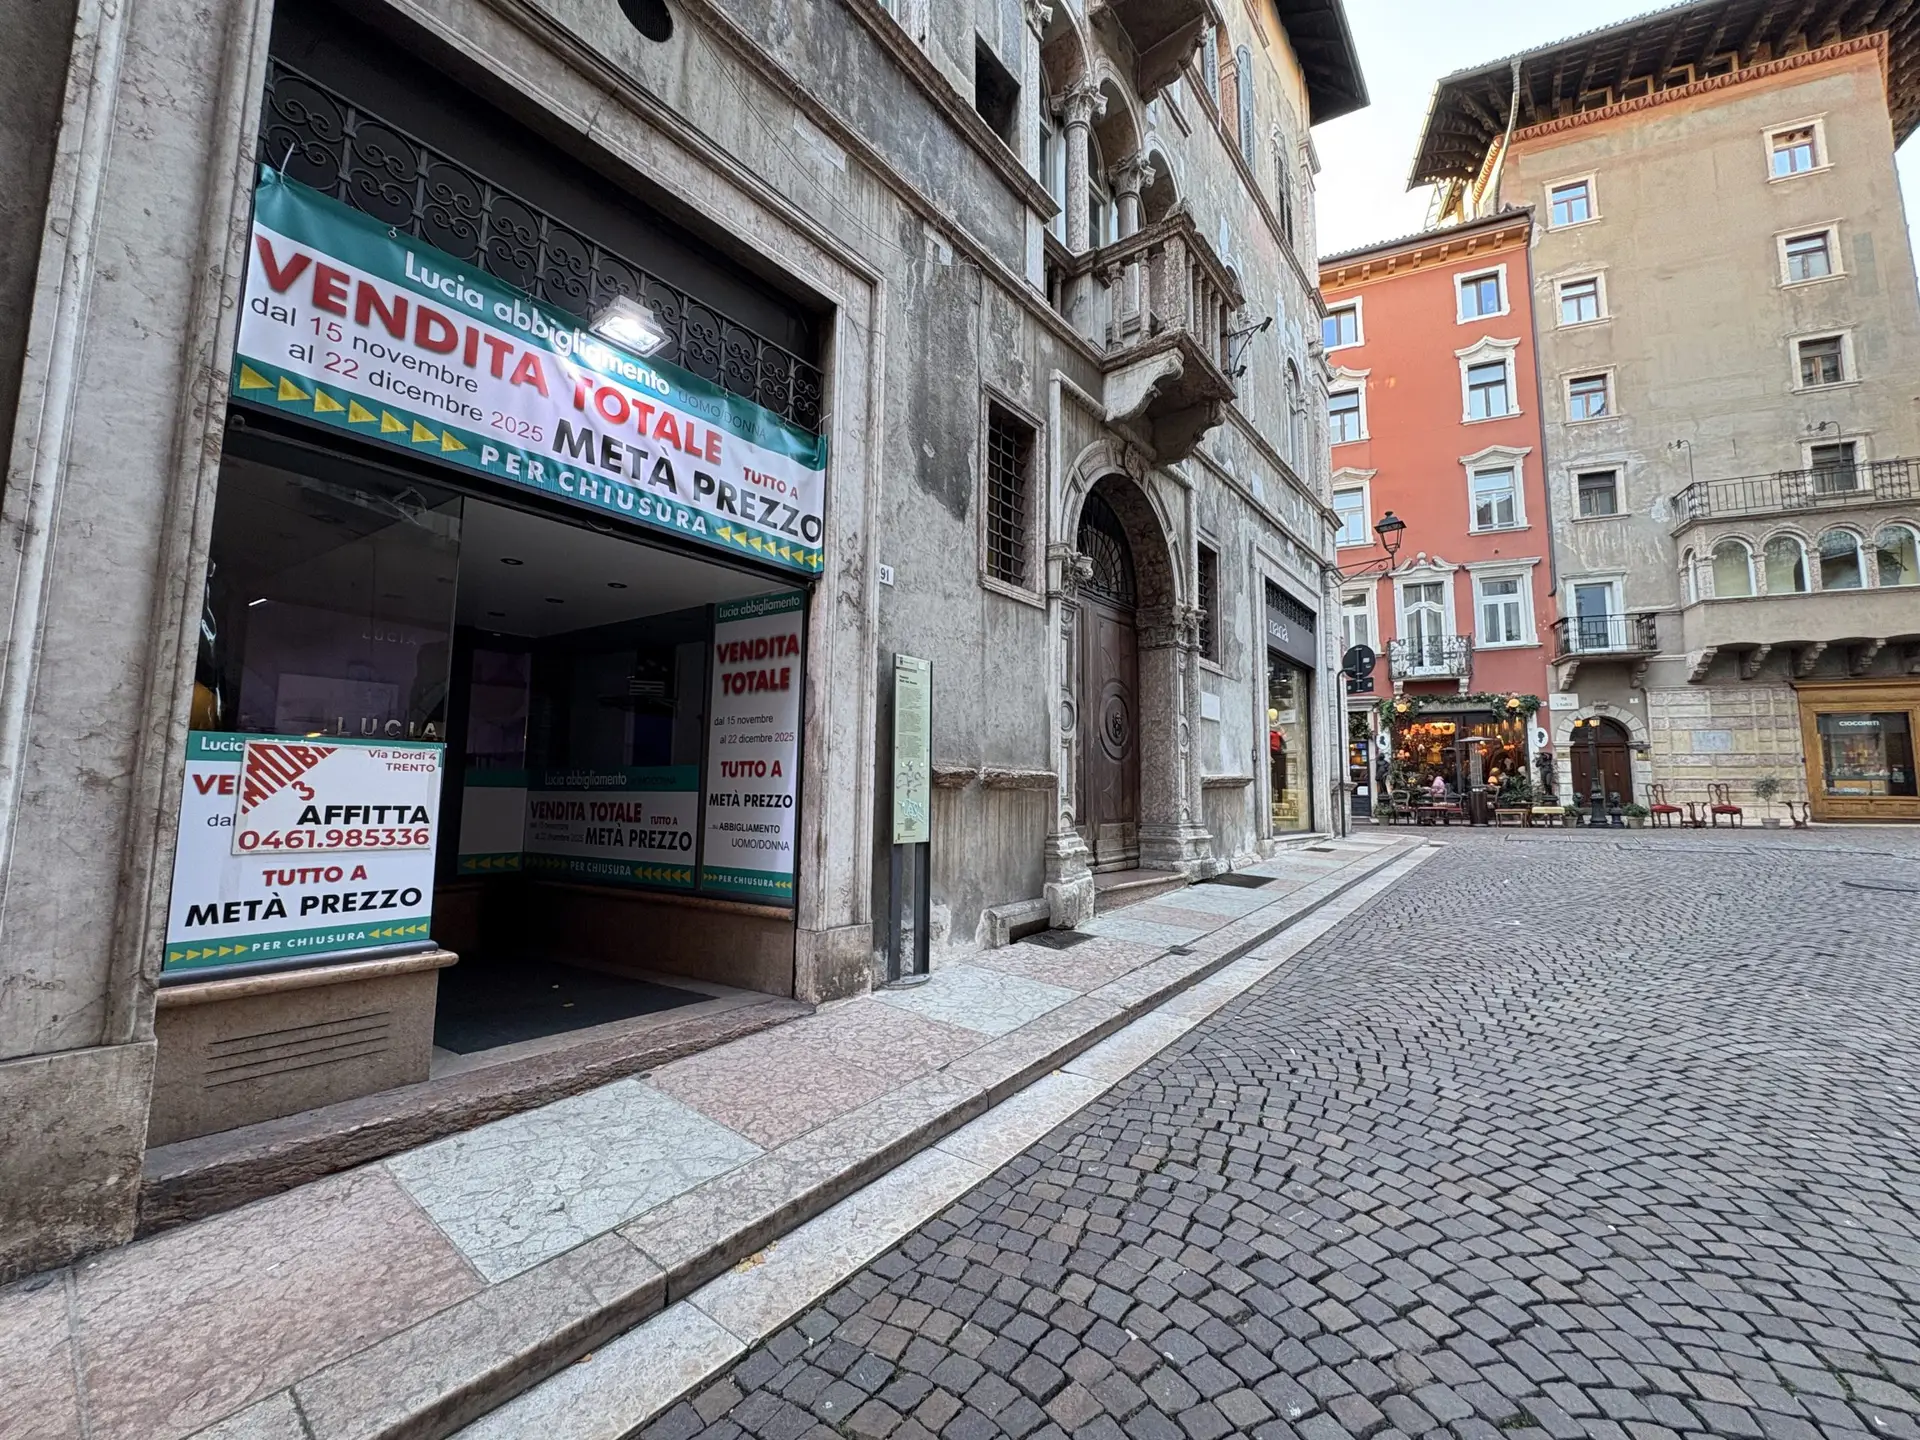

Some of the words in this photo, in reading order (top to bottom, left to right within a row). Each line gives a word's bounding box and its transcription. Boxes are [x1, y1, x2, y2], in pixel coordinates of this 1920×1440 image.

[251, 297, 296, 327] dal
[310, 317, 342, 343] 15
[353, 336, 478, 393] novembre
[255, 233, 549, 397] VENDITA
[568, 372, 722, 464] TOTALE
[405, 251, 484, 311] Lucia
[494, 299, 670, 395] abbigliamento
[678, 391, 767, 440] UOMO/DONNA
[289, 343, 313, 365] al
[324, 352, 360, 379] 22
[369, 369, 483, 421] dicembre
[491, 411, 543, 442] 2025
[481, 444, 545, 483] PER
[559, 471, 707, 535] CHIUSURA
[552, 419, 678, 494] METÀ
[693, 470, 822, 543] PREZZO
[743, 467, 786, 493] TUTTO
[790, 486, 799, 500] A
[881, 567, 889, 582] 91
[719, 606, 738, 618] Lucia
[741, 596, 800, 615] abbigliamento
[717, 634, 799, 664] VENDITA
[722, 667, 790, 696] TOTALE
[336, 717, 437, 739] LUCIA
[714, 716, 724, 726] dal
[727, 716, 735, 725] 15
[737, 714, 773, 725] novembre
[720, 734, 726, 744] al
[728, 734, 737, 743] 22
[739, 733, 773, 744] dicembre
[775, 732, 794, 742] 2025
[368, 750, 389, 760] Via
[392, 751, 426, 761] Dordi
[429, 752, 437, 761] 4
[386, 763, 435, 773] TRENTO
[720, 760, 766, 778] TUTTO
[771, 760, 782, 778] A
[709, 790, 739, 807] METÀ
[744, 794, 793, 808] PREZZO
[207, 813, 237, 827] dal
[297, 805, 430, 825] AFFITTA
[531, 801, 585, 820] VENDITA
[590, 802, 642, 823] TOTALE
[650, 816, 671, 825] TUTTO
[673, 816, 678, 825] A
[585, 823, 624, 847] METÀ
[629, 829, 692, 851] PREZZO
[719, 822, 781, 834] ABBIGLIAMENTO
[238, 829, 430, 850] 0461.985336
[731, 838, 789, 851] UOMO/DONNA
[262, 866, 343, 886] TUTTO
[350, 865, 368, 880] A
[570, 860, 584, 871] PER
[587, 861, 631, 876] CHIUSURA
[718, 874, 734, 883] PER
[734, 876, 774, 888] CHIUSURA
[185, 892, 287, 927] METÀ
[300, 887, 422, 916] PREZZO
[252, 940, 281, 952] PER
[287, 931, 365, 948] CHIUSURA
